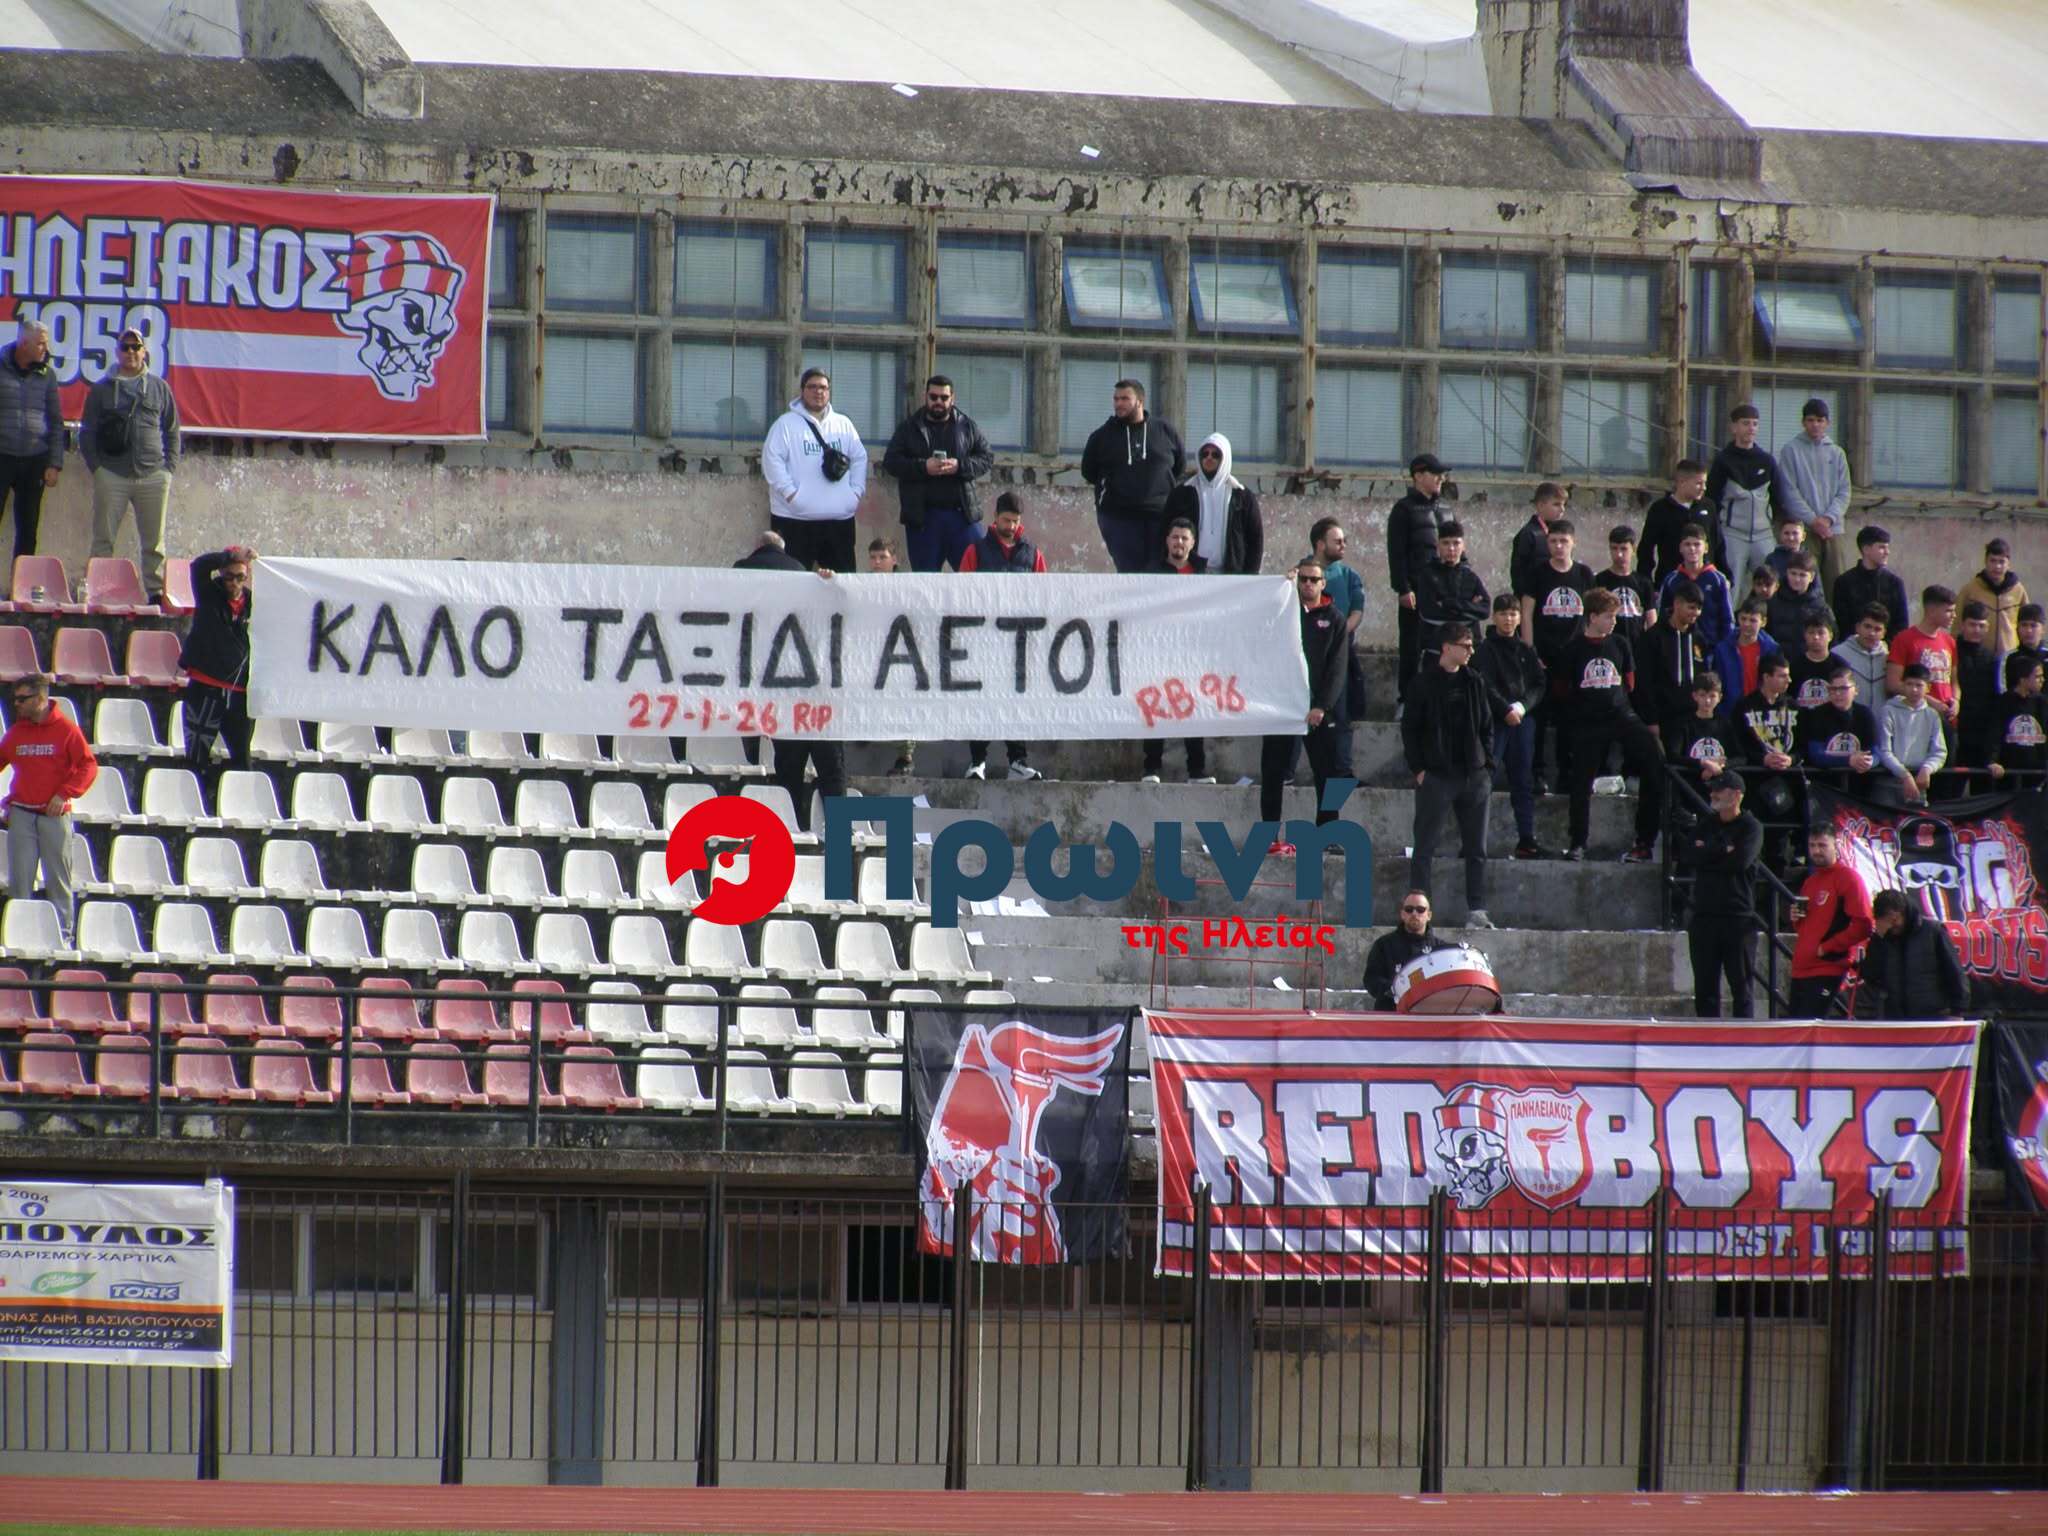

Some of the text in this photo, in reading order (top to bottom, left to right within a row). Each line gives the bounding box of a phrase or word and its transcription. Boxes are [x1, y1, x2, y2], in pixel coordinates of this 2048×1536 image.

[307, 601, 1122, 696] ΚΑΛΟ ΤΑΞΙΔΙ ΑΕΤΟΙ
[1200, 673, 1246, 713] 96
[628, 692, 833, 735] 27-1-26 RIP
[1510, 1101, 1574, 1122] ΠΑΝΗΛΕΙΑΚΟΣ
[1184, 1079, 1944, 1209] RED BOYS
[9, 1189, 49, 1204] 2004
[112, 1286, 177, 1299] TORK
[41, 1313, 81, 1325] ΔΗΜ.
[86, 1315, 217, 1328] ΒΑΣΙΛΟΠΟΥΛΟΣ
[135, 1329, 195, 1340] 20153
